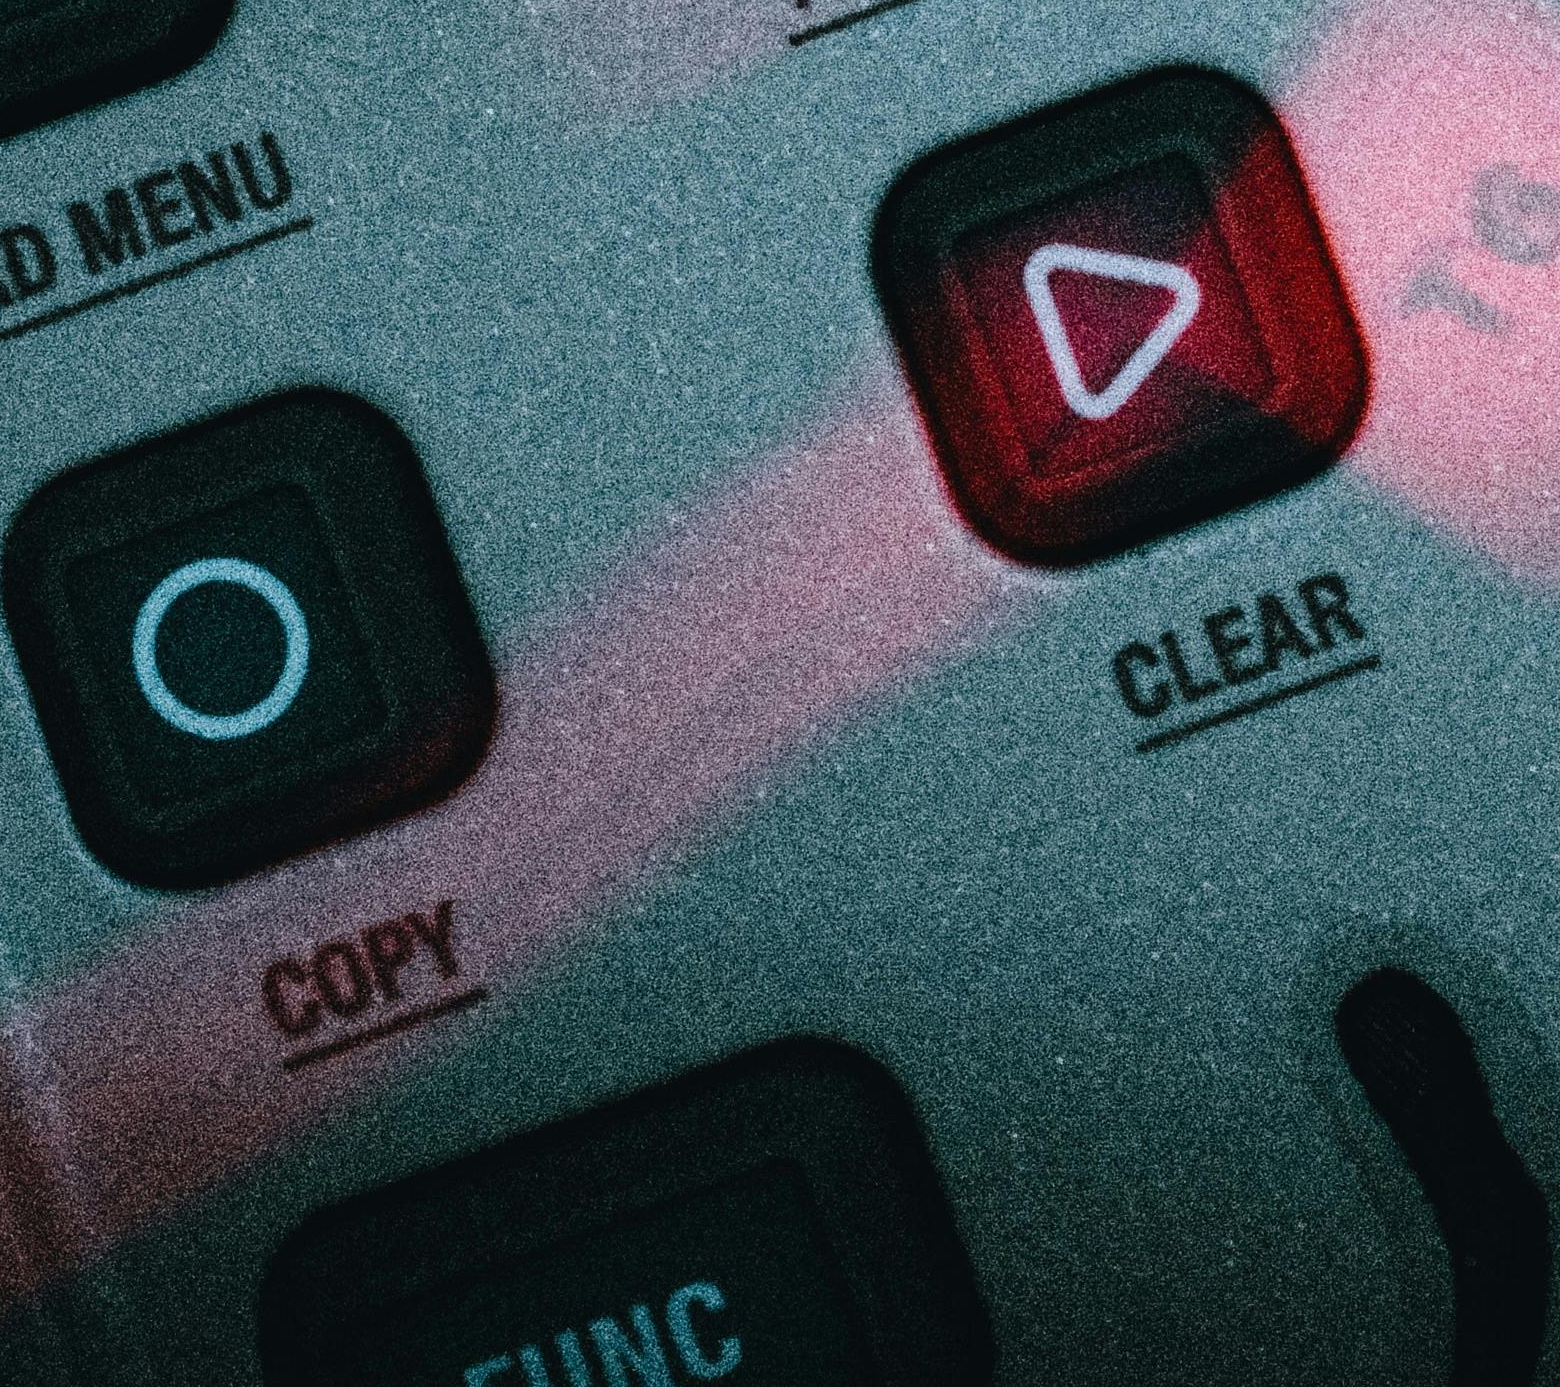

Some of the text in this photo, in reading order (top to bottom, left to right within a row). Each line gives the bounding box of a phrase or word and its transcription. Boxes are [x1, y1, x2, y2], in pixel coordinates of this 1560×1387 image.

[73, 129, 294, 275] MENU
[1114, 571, 1369, 722] CLEAR
[263, 897, 462, 1039] COPY
